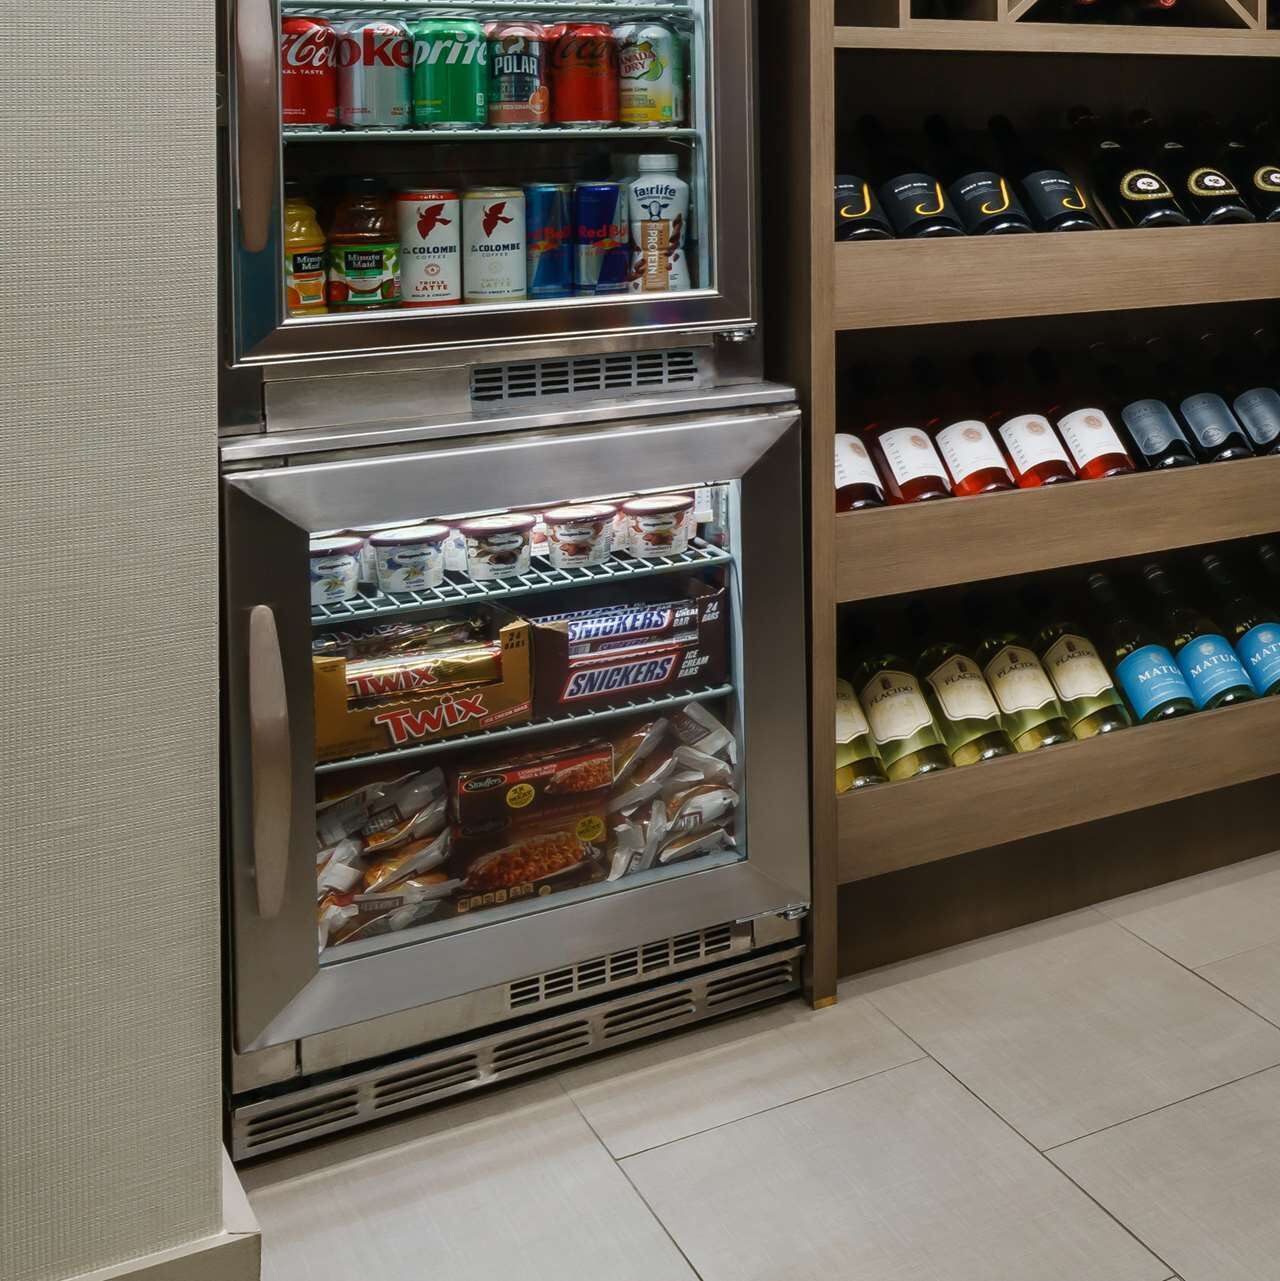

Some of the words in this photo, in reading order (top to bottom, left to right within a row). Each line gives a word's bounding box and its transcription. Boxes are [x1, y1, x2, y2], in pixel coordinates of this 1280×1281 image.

[338, 28, 414, 67] oke
[412, 32, 487, 72] prite
[495, 55, 537, 75] POLAR
[624, 61, 647, 74] DRY
[579, 225, 606, 239] Red
[413, 245, 457, 254] COLOMBE
[479, 242, 520, 253] COLOMBE
[348, 253, 380, 263] Minute
[352, 261, 375, 269] Maid
[707, 602, 719, 613] 24
[702, 612, 719, 623] BARS
[569, 609, 668, 641] SNICKERS
[509, 632, 521, 640] 24
[682, 656, 709, 668] CREAM
[1056, 650, 1096, 666] PLACIDO
[678, 666, 699, 678] BARS
[996, 662, 1038, 678] PLACIDO
[1190, 654, 1239, 677] MATUA
[569, 657, 673, 697] SNICKERS
